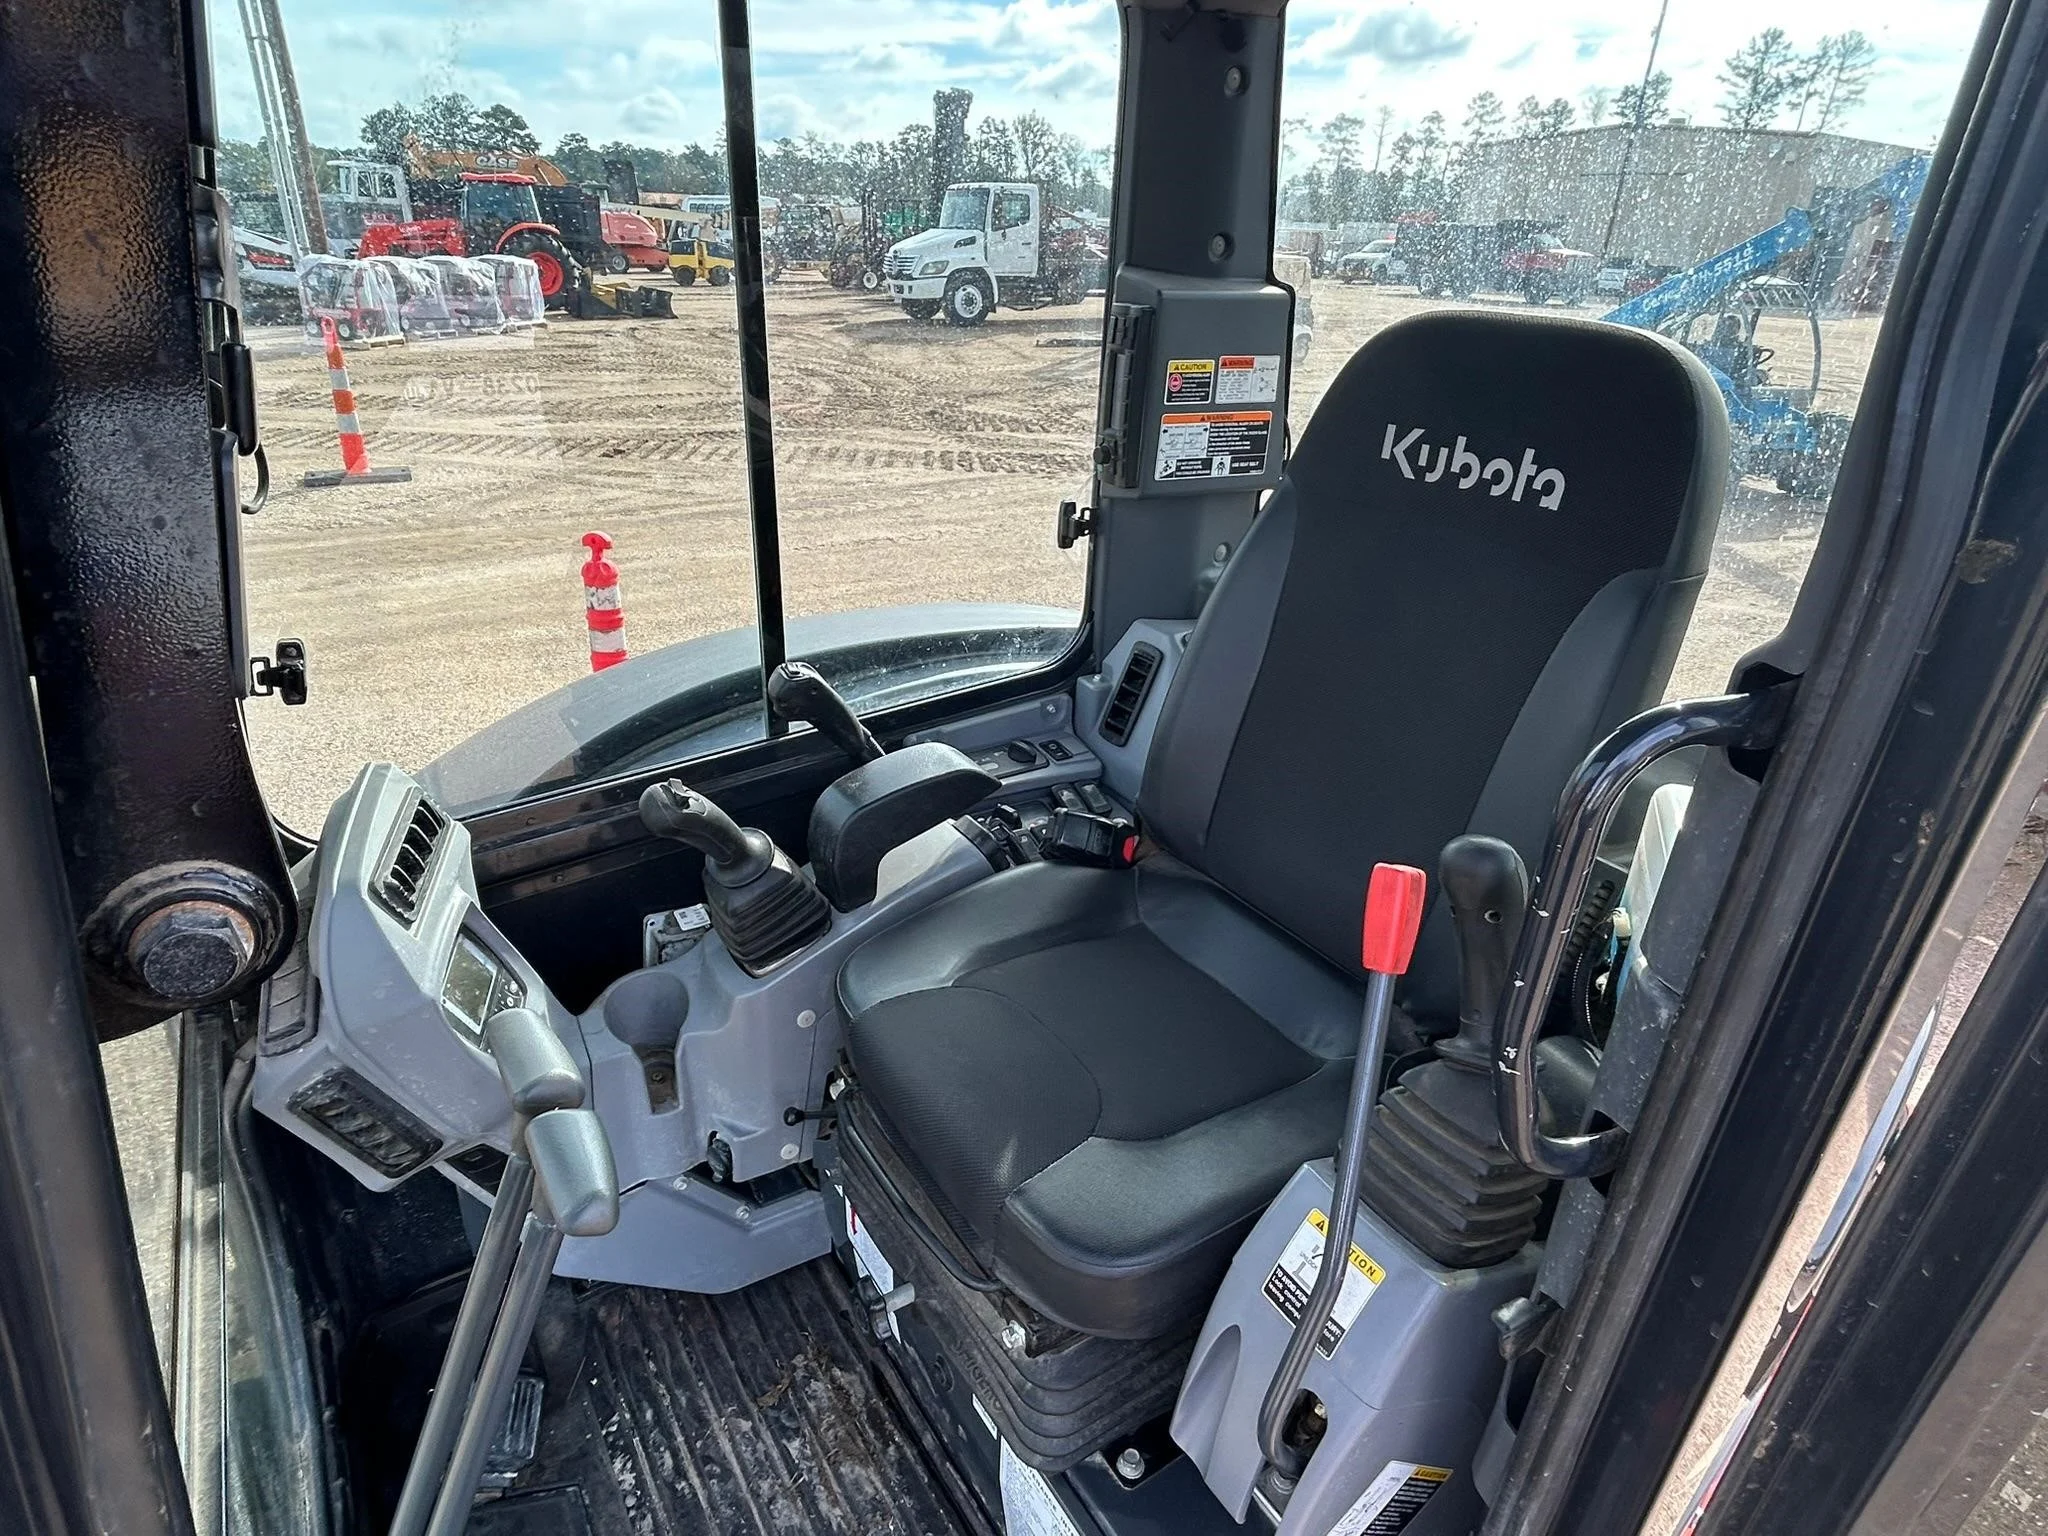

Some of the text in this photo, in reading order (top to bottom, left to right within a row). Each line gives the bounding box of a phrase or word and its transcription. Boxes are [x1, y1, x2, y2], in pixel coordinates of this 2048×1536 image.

[475, 152, 519, 169] CASE
[1180, 363, 1207, 372] CAUTION
[1380, 423, 1566, 511] Kubota
[1349, 1249, 1377, 1277] TION
[1268, 1282, 1285, 1303] leaving
[1271, 1275, 1284, 1290] Lock
[1283, 1289, 1301, 1309] control
[1275, 1267, 1283, 1278] TO
[1281, 1274, 1297, 1293] AVOID
